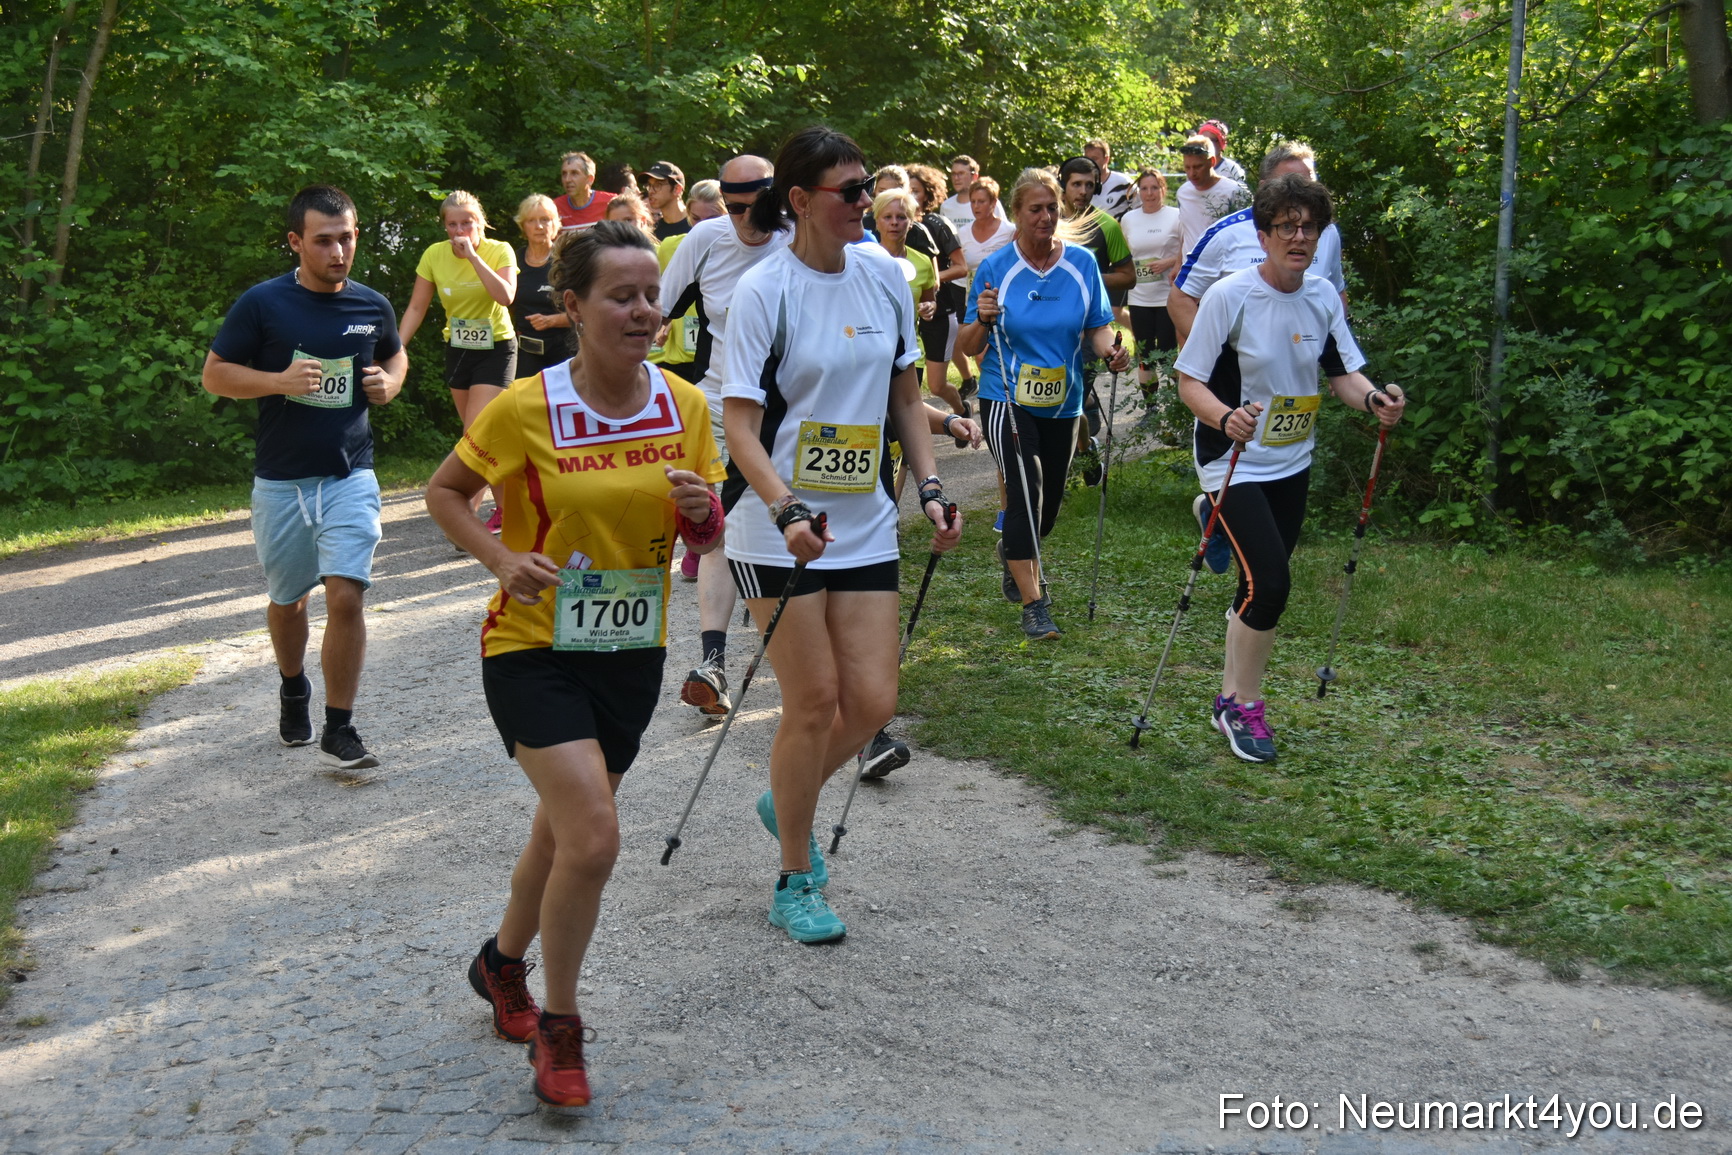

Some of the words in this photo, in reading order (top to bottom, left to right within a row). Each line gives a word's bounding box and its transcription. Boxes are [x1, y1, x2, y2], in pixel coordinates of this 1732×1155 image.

[456, 329, 488, 342] 1292
[1024, 379, 1062, 397] 1080
[1271, 411, 1312, 432] 2378
[557, 453, 618, 474] MAX
[625, 442, 686, 467] BÖGL
[805, 446, 871, 474] 2385
[820, 473, 847, 482] Schmid
[571, 598, 649, 628] 1700
[589, 630, 608, 638] Wild
[609, 629, 630, 637] Petra
